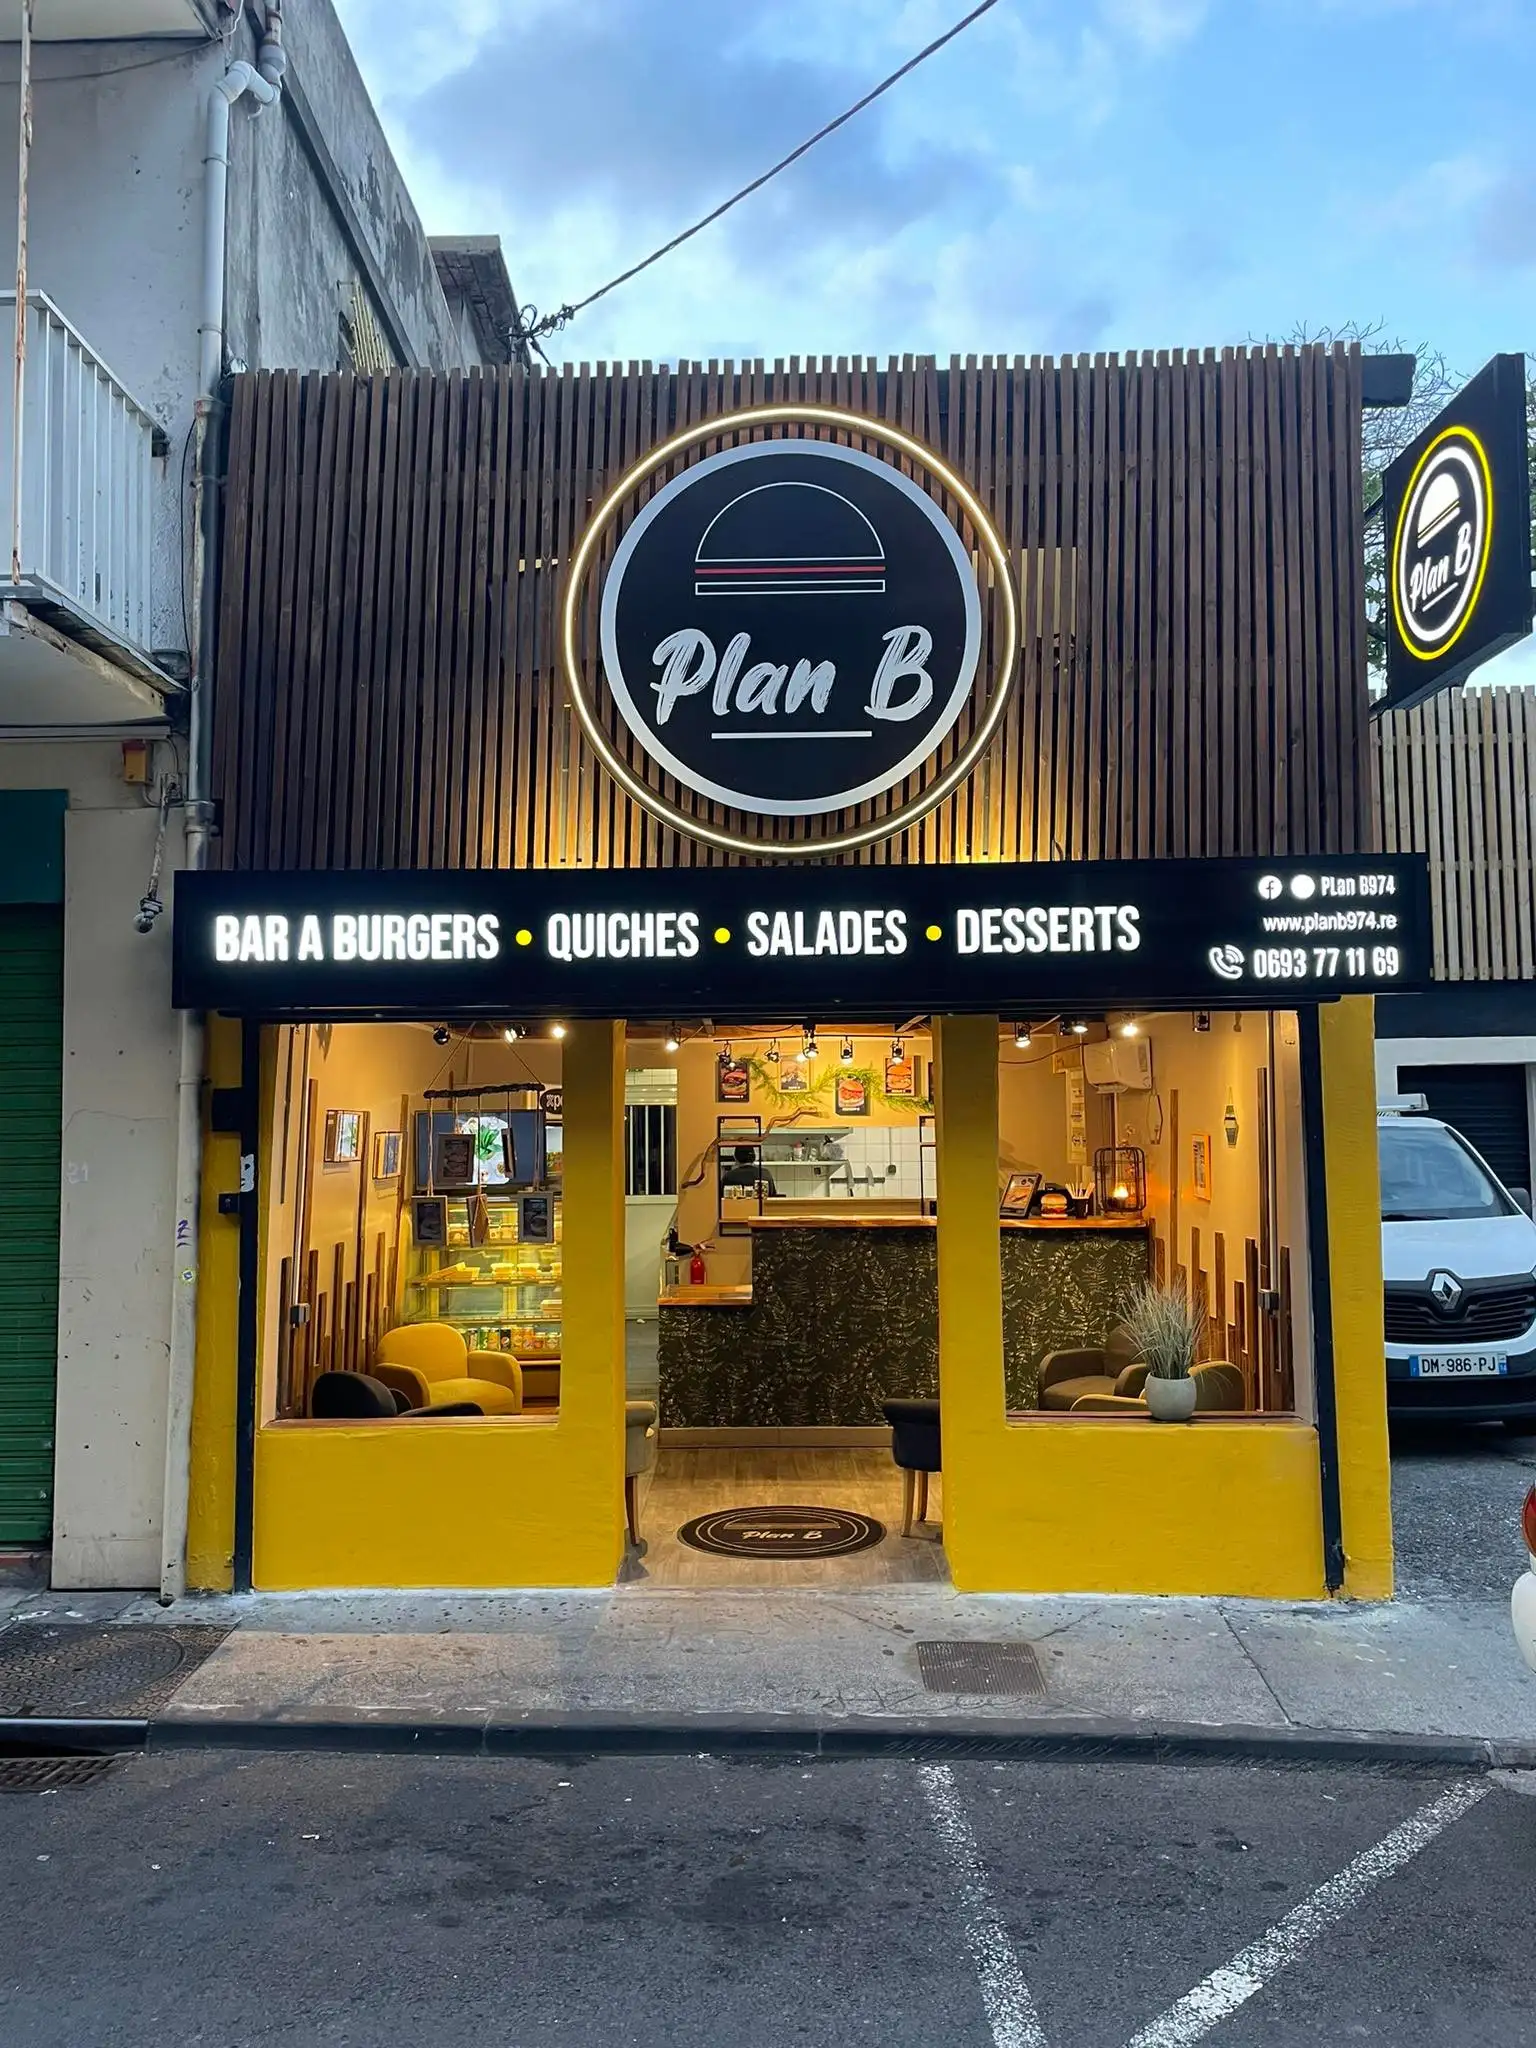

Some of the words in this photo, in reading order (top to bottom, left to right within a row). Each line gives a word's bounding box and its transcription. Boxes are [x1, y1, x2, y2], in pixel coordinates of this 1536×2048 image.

[1409, 555, 1450, 612] Plan
[1454, 521, 1472, 576] B
[650, 628, 836, 726] Plan
[864, 625, 934, 722] B
[1359, 874, 1396, 896] B974
[214, 914, 289, 961] BAR
[298, 914, 324, 960] A
[333, 913, 500, 960] BURGERS
[547, 911, 699, 961] QUICHES
[747, 909, 907, 957] SALADES
[957, 905, 1140, 954] DESSERTS
[1263, 911, 1397, 935] www.planb974.re
[1254, 948, 1307, 978] 0693
[1313, 947, 1340, 977] 77
[1346, 947, 1365, 976] 11
[1372, 946, 1399, 976] 69
[1421, 1356, 1496, 1374] DM-986-PJ
[742, 1530, 795, 1540] Plan
[803, 1530, 823, 1540] B
